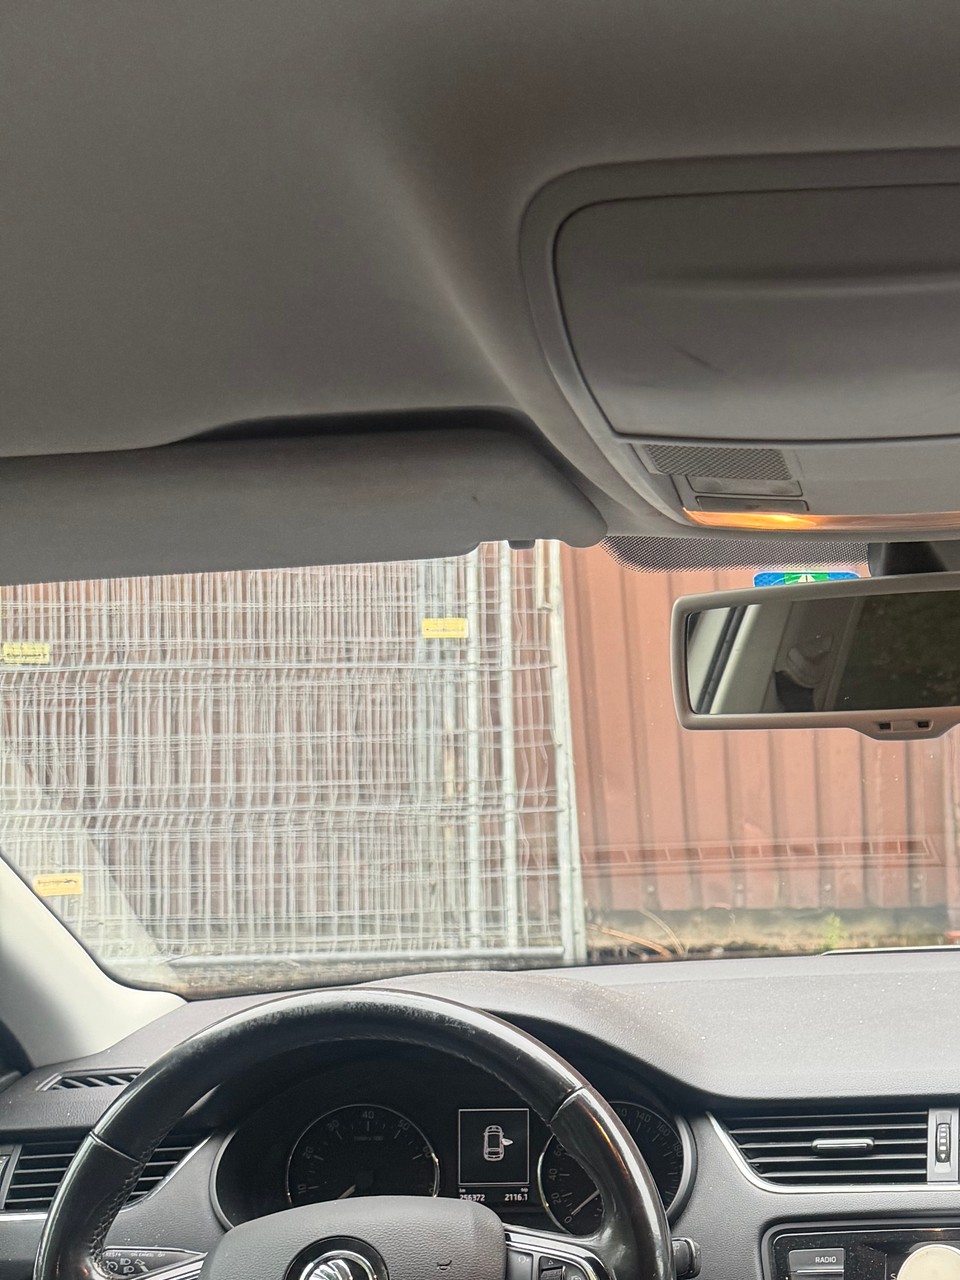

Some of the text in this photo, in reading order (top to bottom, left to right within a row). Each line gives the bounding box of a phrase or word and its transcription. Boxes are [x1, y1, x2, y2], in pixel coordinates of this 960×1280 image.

[362, 1111, 375, 1120] 40
[636, 1110, 651, 1124] 140
[504, 1193, 529, 1202] 2116.1
